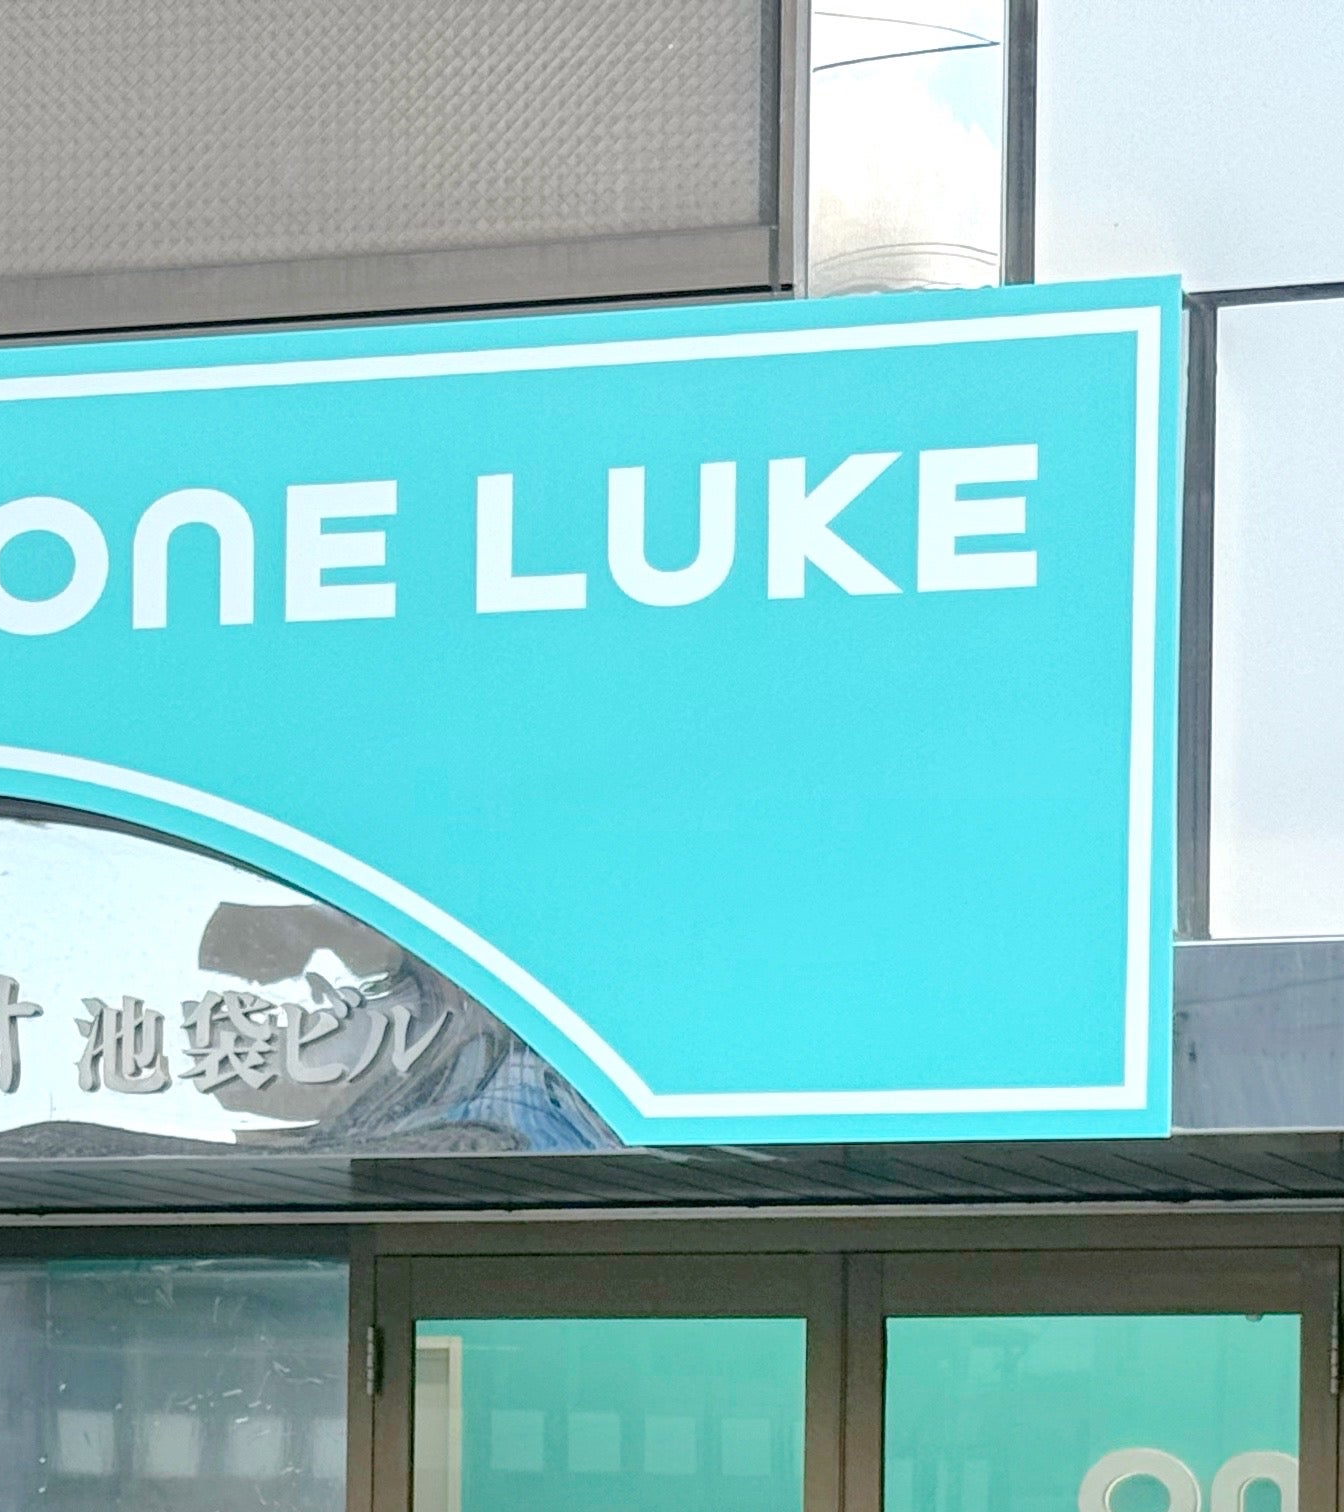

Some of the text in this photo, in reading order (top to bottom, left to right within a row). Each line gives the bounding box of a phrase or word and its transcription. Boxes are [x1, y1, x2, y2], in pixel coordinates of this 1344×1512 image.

[475, 443, 1039, 615] LUKE
[73, 972, 454, 1094] 池袋ビル
